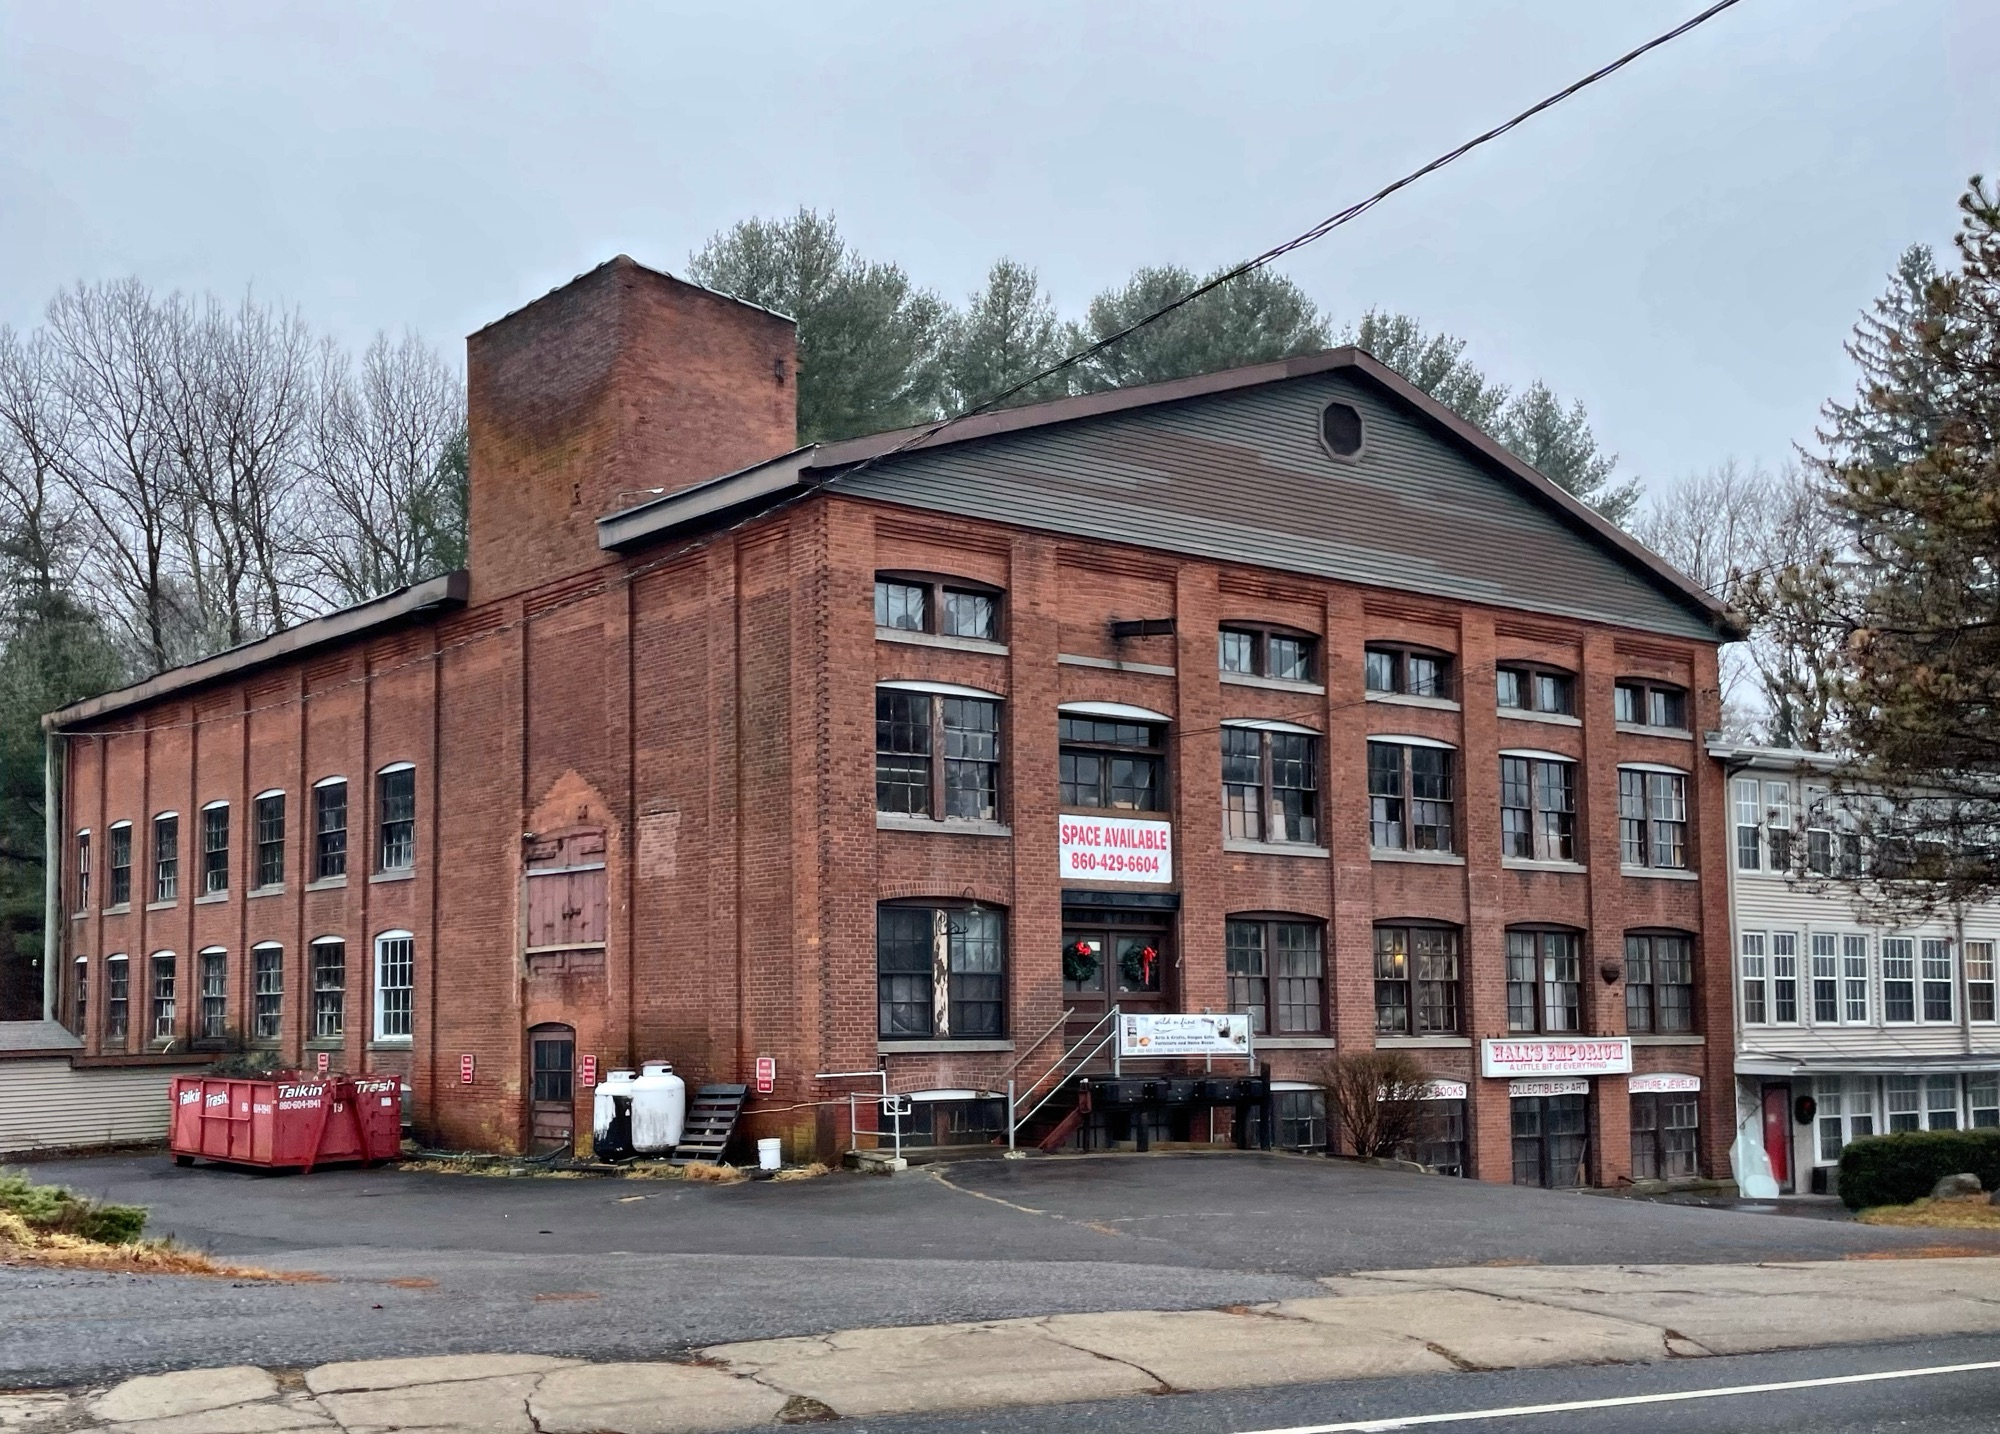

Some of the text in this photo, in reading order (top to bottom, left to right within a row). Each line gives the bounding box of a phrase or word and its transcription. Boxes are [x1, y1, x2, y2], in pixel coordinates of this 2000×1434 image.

[1062, 824, 1167, 850] SPACE AVAILABLE
[1071, 852, 1159, 873] 860-429-6604
[1492, 1043, 1623, 1063] HALL'S EMPORIUM
[355, 1080, 395, 1094] Trash
[1434, 1086, 1464, 1097] BOOKS
[1508, 1082, 1586, 1095] COLLECTIBLES ART
[1667, 1079, 1698, 1089] JEWELRY
[206, 1091, 227, 1108] Trash
